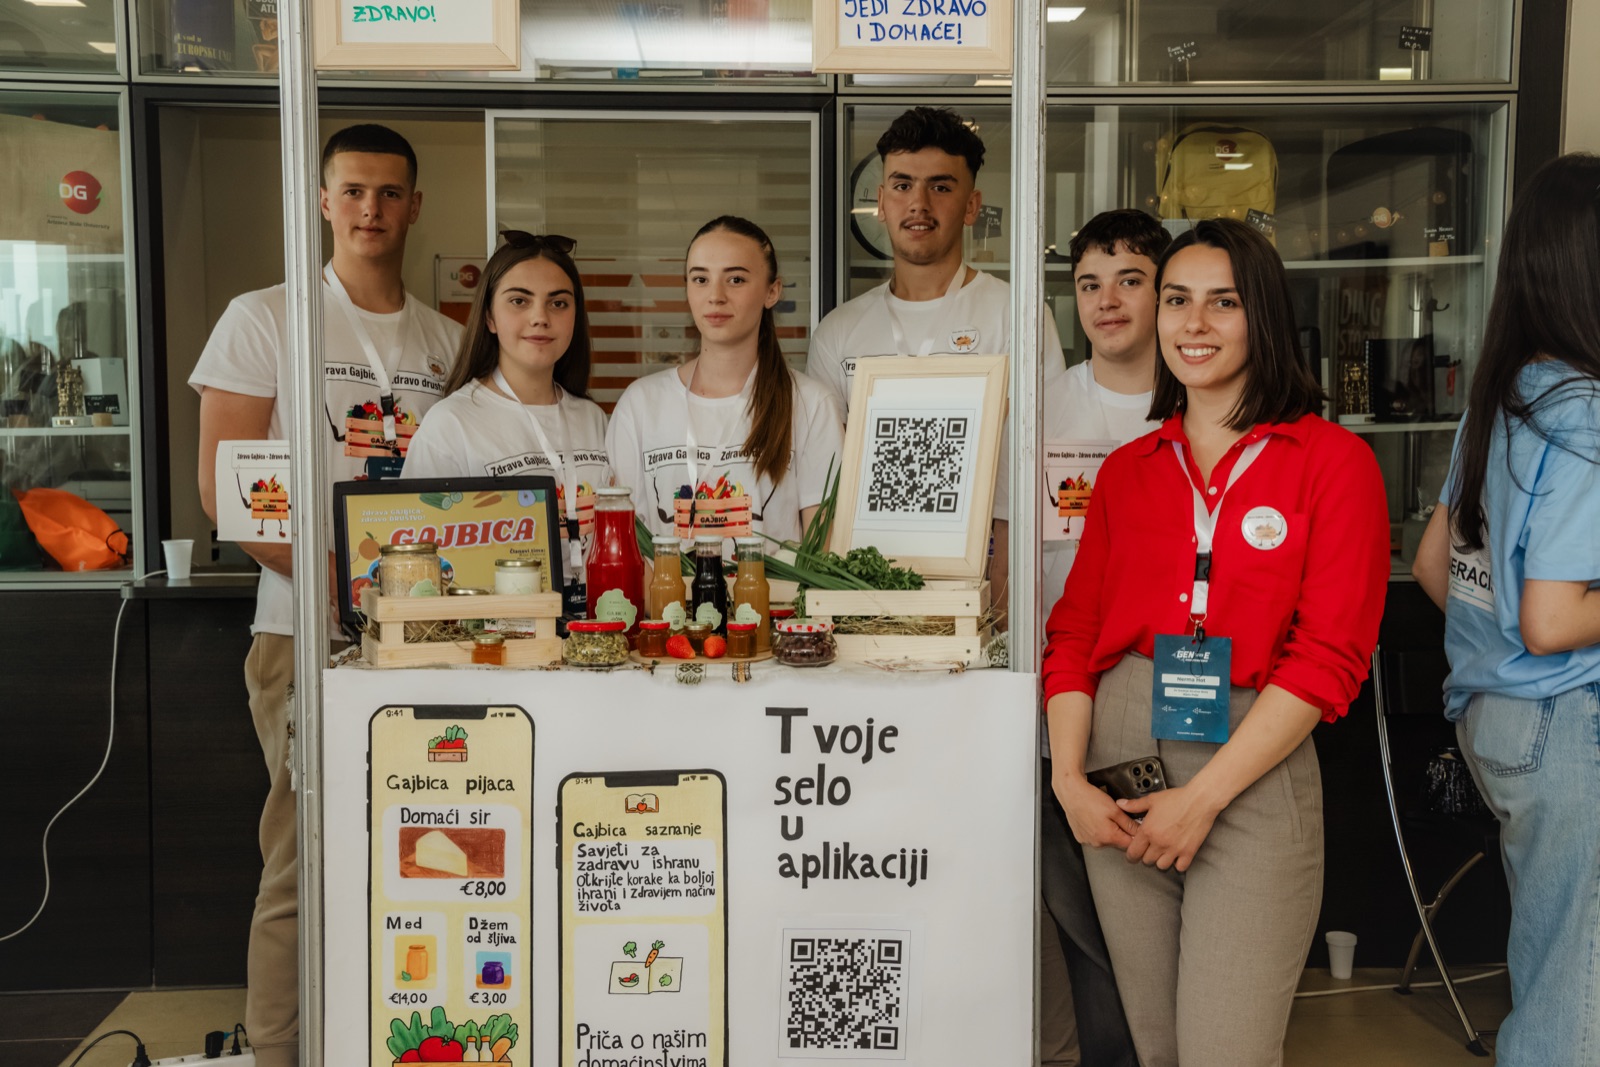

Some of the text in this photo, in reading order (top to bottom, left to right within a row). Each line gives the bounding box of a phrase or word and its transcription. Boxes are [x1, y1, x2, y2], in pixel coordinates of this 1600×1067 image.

[352, 5, 437, 23] ZDRAVO!
[845, 0, 987, 18] JEDI ZDRAVO
[856, 21, 962, 45] I DOMAĆE!
[349, 366, 378, 381] Gajbic
[391, 374, 420, 386] dravo
[490, 459, 524, 478] Zdrava
[558, 453, 589, 464] Zavo
[647, 450, 673, 466] Zdrava
[675, 449, 711, 461] Gaica
[391, 517, 535, 548] GAJBICA
[386, 709, 404, 718] 9:41
[765, 706, 899, 765] Tvoje
[386, 774, 515, 795] Gajbica pijaca
[575, 777, 593, 785] 9:41
[773, 763, 852, 806] selo
[400, 807, 492, 826] Domaći sir
[573, 822, 702, 839] Gajbica saznanje
[780, 815, 804, 841] u
[577, 841, 660, 859] Savjeti za
[577, 855, 700, 872] zadravu ishranu
[777, 841, 928, 890] aplikaciji
[576, 869, 715, 888] Otkrijte korake ka boljoj
[459, 880, 507, 899] €8,00
[577, 887, 617, 901] ihrani
[578, 899, 621, 913] života
[386, 916, 422, 930] Med
[469, 917, 509, 931] Džem
[466, 931, 517, 947] od šljiva
[388, 992, 428, 1006] €14,00
[576, 1022, 707, 1050] Priča o našim
